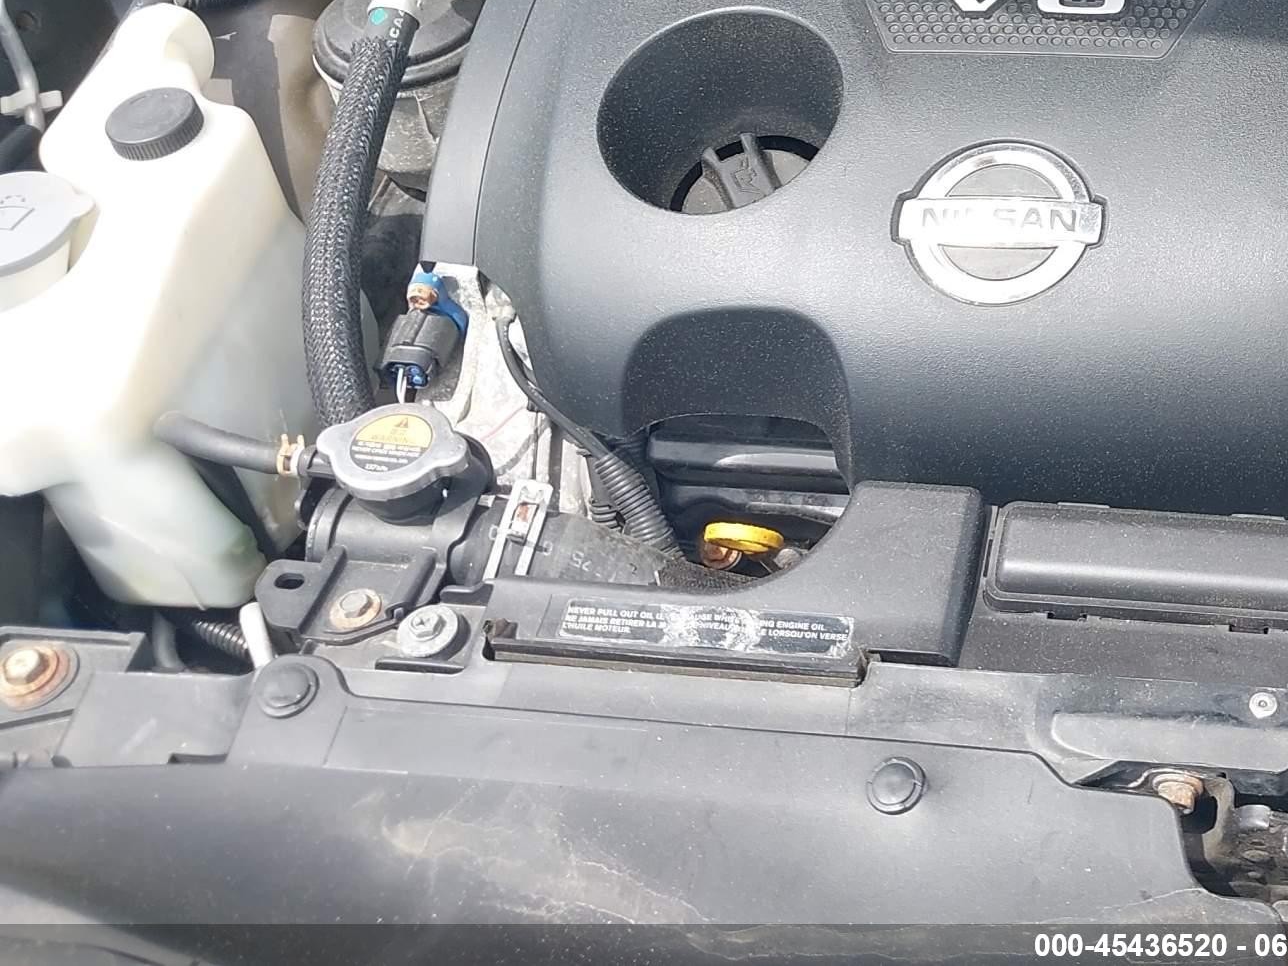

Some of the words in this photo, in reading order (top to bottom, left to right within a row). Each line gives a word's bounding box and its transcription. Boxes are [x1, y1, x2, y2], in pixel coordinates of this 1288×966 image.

[568, 606, 596, 615] NEVER
[597, 608, 618, 617] PULL
[619, 610, 638, 618] OUT
[639, 611, 655, 620] OIL
[565, 614, 577, 623] NE
[579, 616, 609, 625] JAMAIS
[610, 618, 645, 628] RETIRER
[647, 620, 658, 628] LA
[775, 621, 811, 631] ENGINE
[768, 630, 818, 640] LORSQU'ON
[819, 633, 848, 642] VERSE
